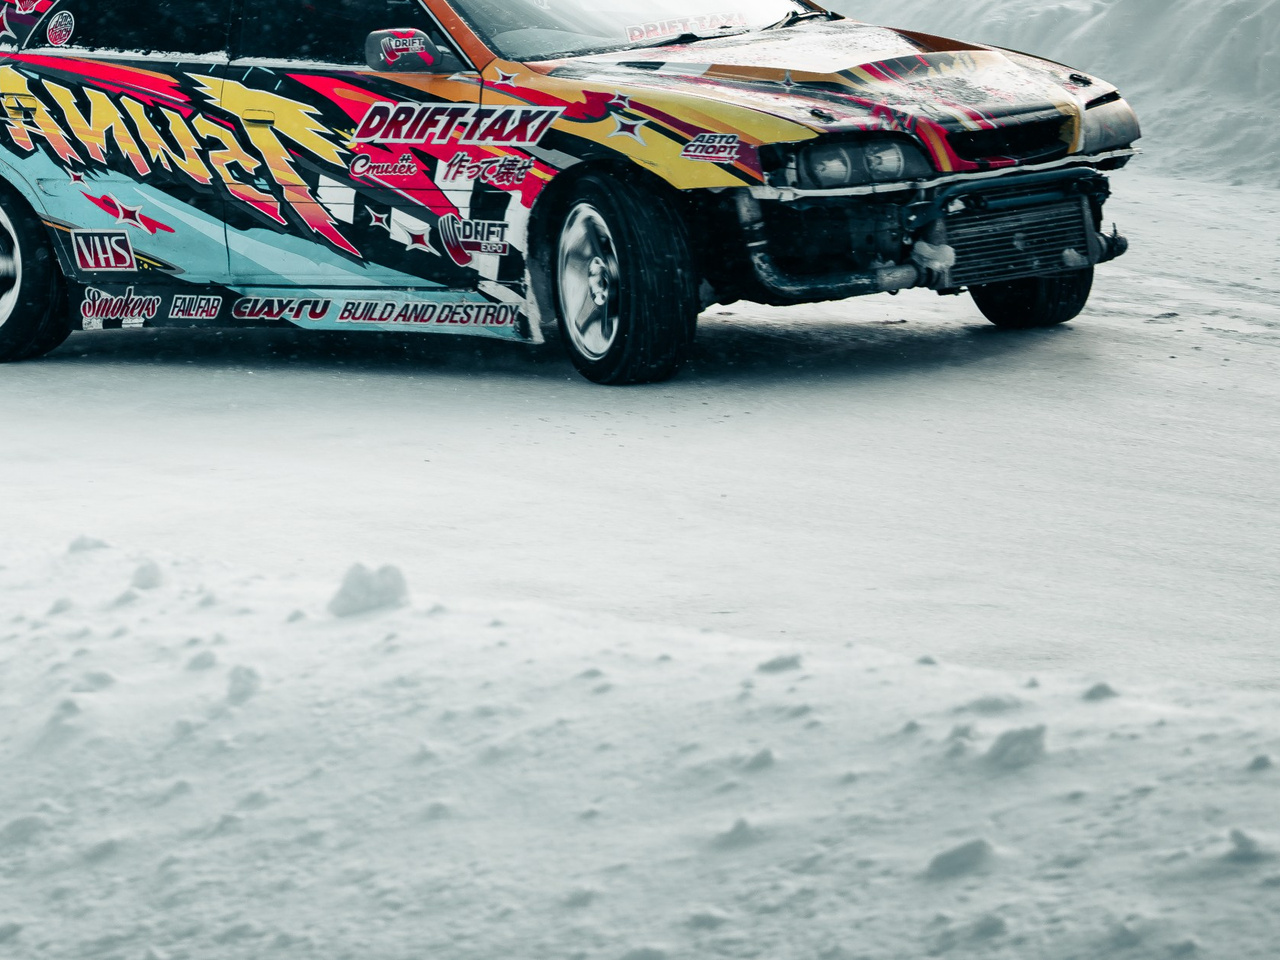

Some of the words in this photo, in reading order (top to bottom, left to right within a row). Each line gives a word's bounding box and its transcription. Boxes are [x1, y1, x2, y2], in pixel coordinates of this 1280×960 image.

[627, 18, 690, 41] DRIFT
[695, 13, 747, 31] TAXI
[394, 38, 424, 48] DRIFT
[355, 105, 471, 141] DRIFT
[462, 108, 559, 142] TAXI
[682, 144, 737, 156] СПОРТ
[692, 134, 738, 145] АВТО
[442, 151, 535, 184] 作って壊せ
[462, 221, 509, 242] DRIFT
[76, 235, 131, 268] VHS
[480, 243, 504, 253] EXPO
[81, 286, 161, 319] Smokers
[339, 301, 394, 322] BUILD
[393, 302, 437, 323] AND
[435, 304, 520, 326] DESTROY
